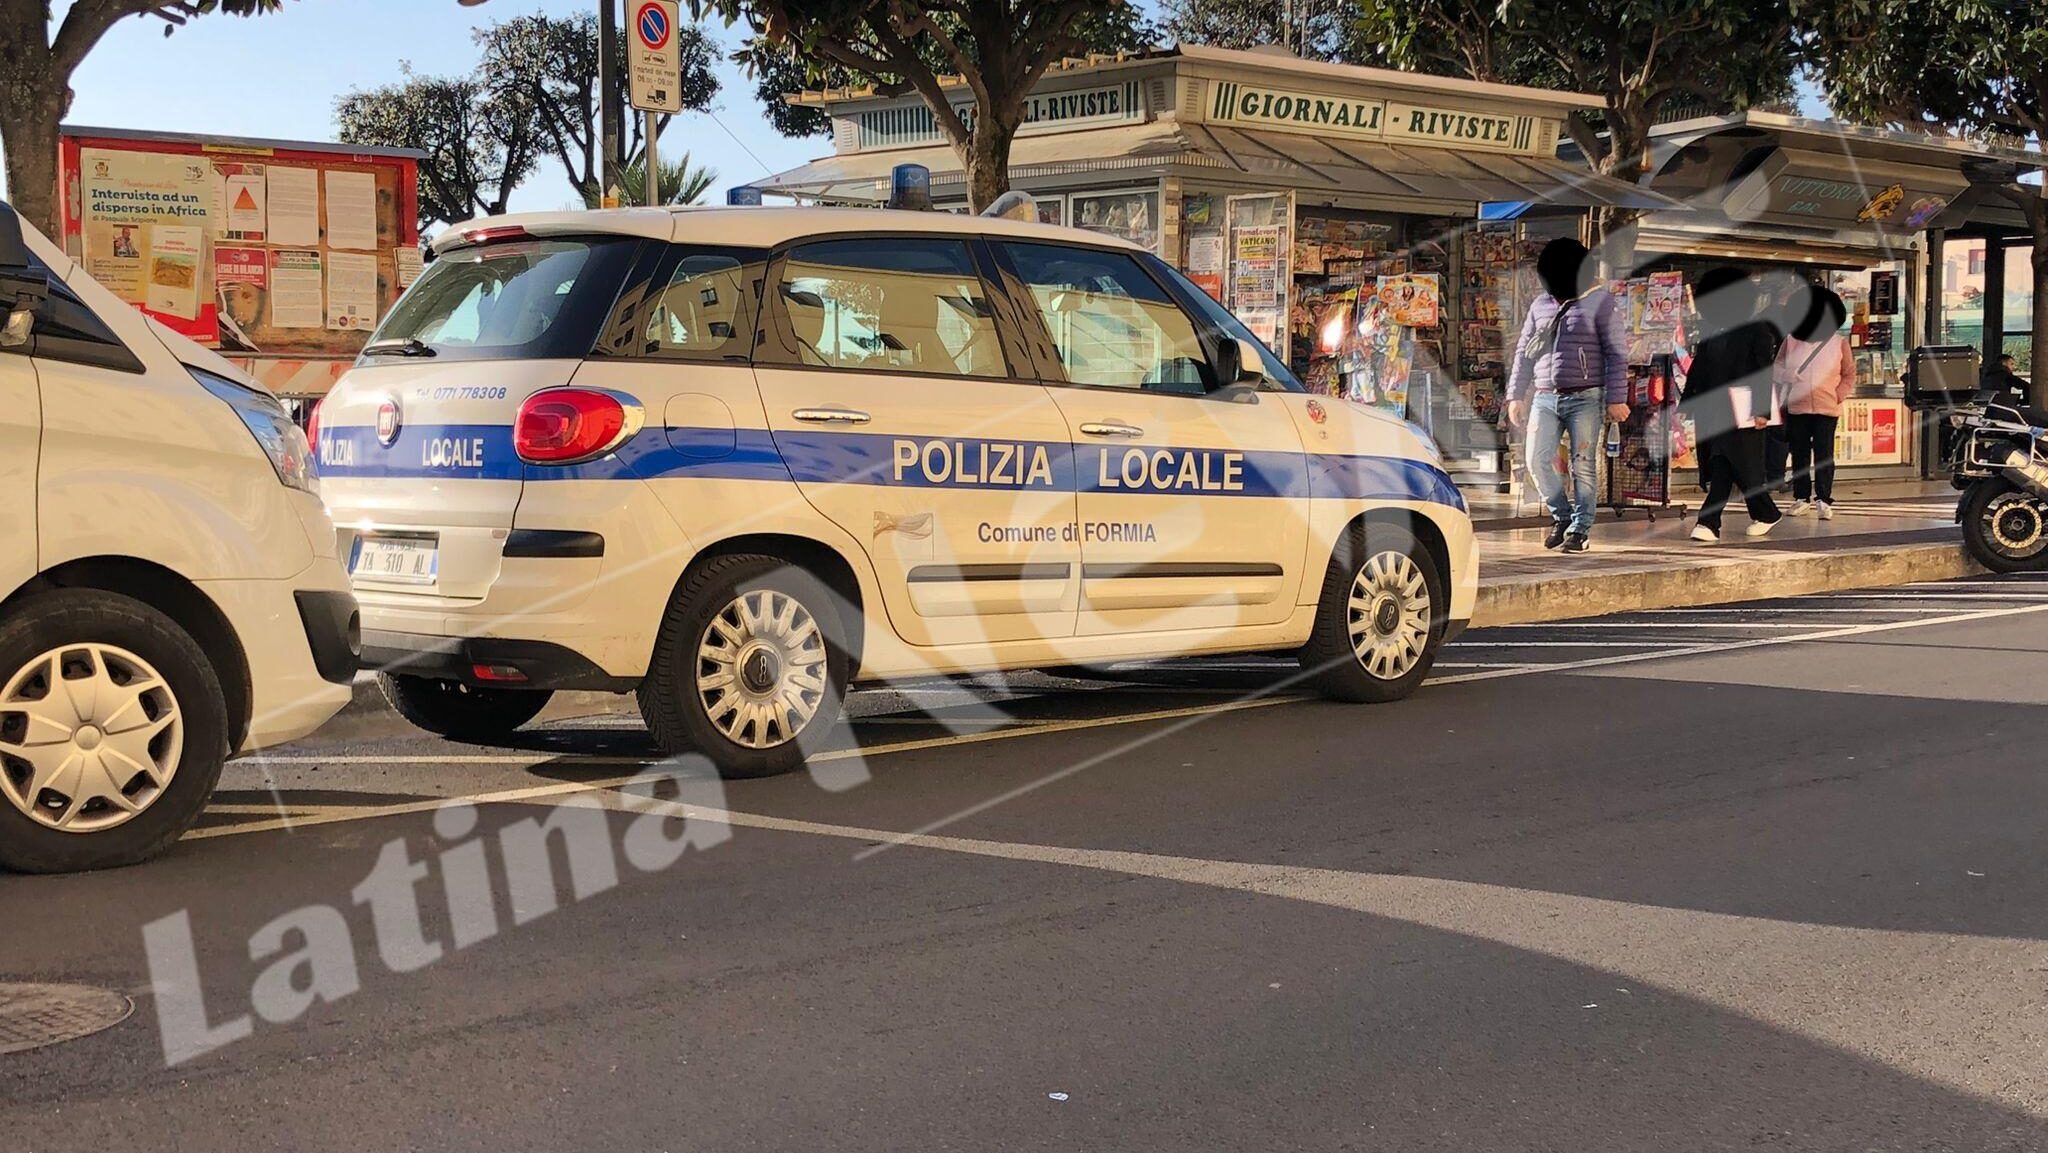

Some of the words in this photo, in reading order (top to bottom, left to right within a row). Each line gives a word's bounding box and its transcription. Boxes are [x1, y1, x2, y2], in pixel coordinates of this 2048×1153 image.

[1240, 92, 1381, 129] GIORNALI
[1408, 110, 1511, 142] RIVISTE
[91, 189, 160, 201] Intervista
[162, 193, 178, 202] ad
[182, 194, 199, 203] un
[92, 201, 149, 214] disperso
[152, 204, 165, 214] in
[167, 205, 207, 217] Africa
[1239, 237, 1276, 246] VATICANO
[458, 386, 507, 399] 778308
[321, 438, 353, 466] POLIZIA
[422, 438, 484, 467] LOCALE
[892, 439, 1054, 486] POLIZIA
[1098, 448, 1245, 491] LOCALE
[978, 522, 1057, 543] Comune
[1061, 521, 1079, 542] di
[1084, 522, 1157, 543] FORMIA
[384, 552, 404, 574] 310
[412, 554, 425, 575] AL
